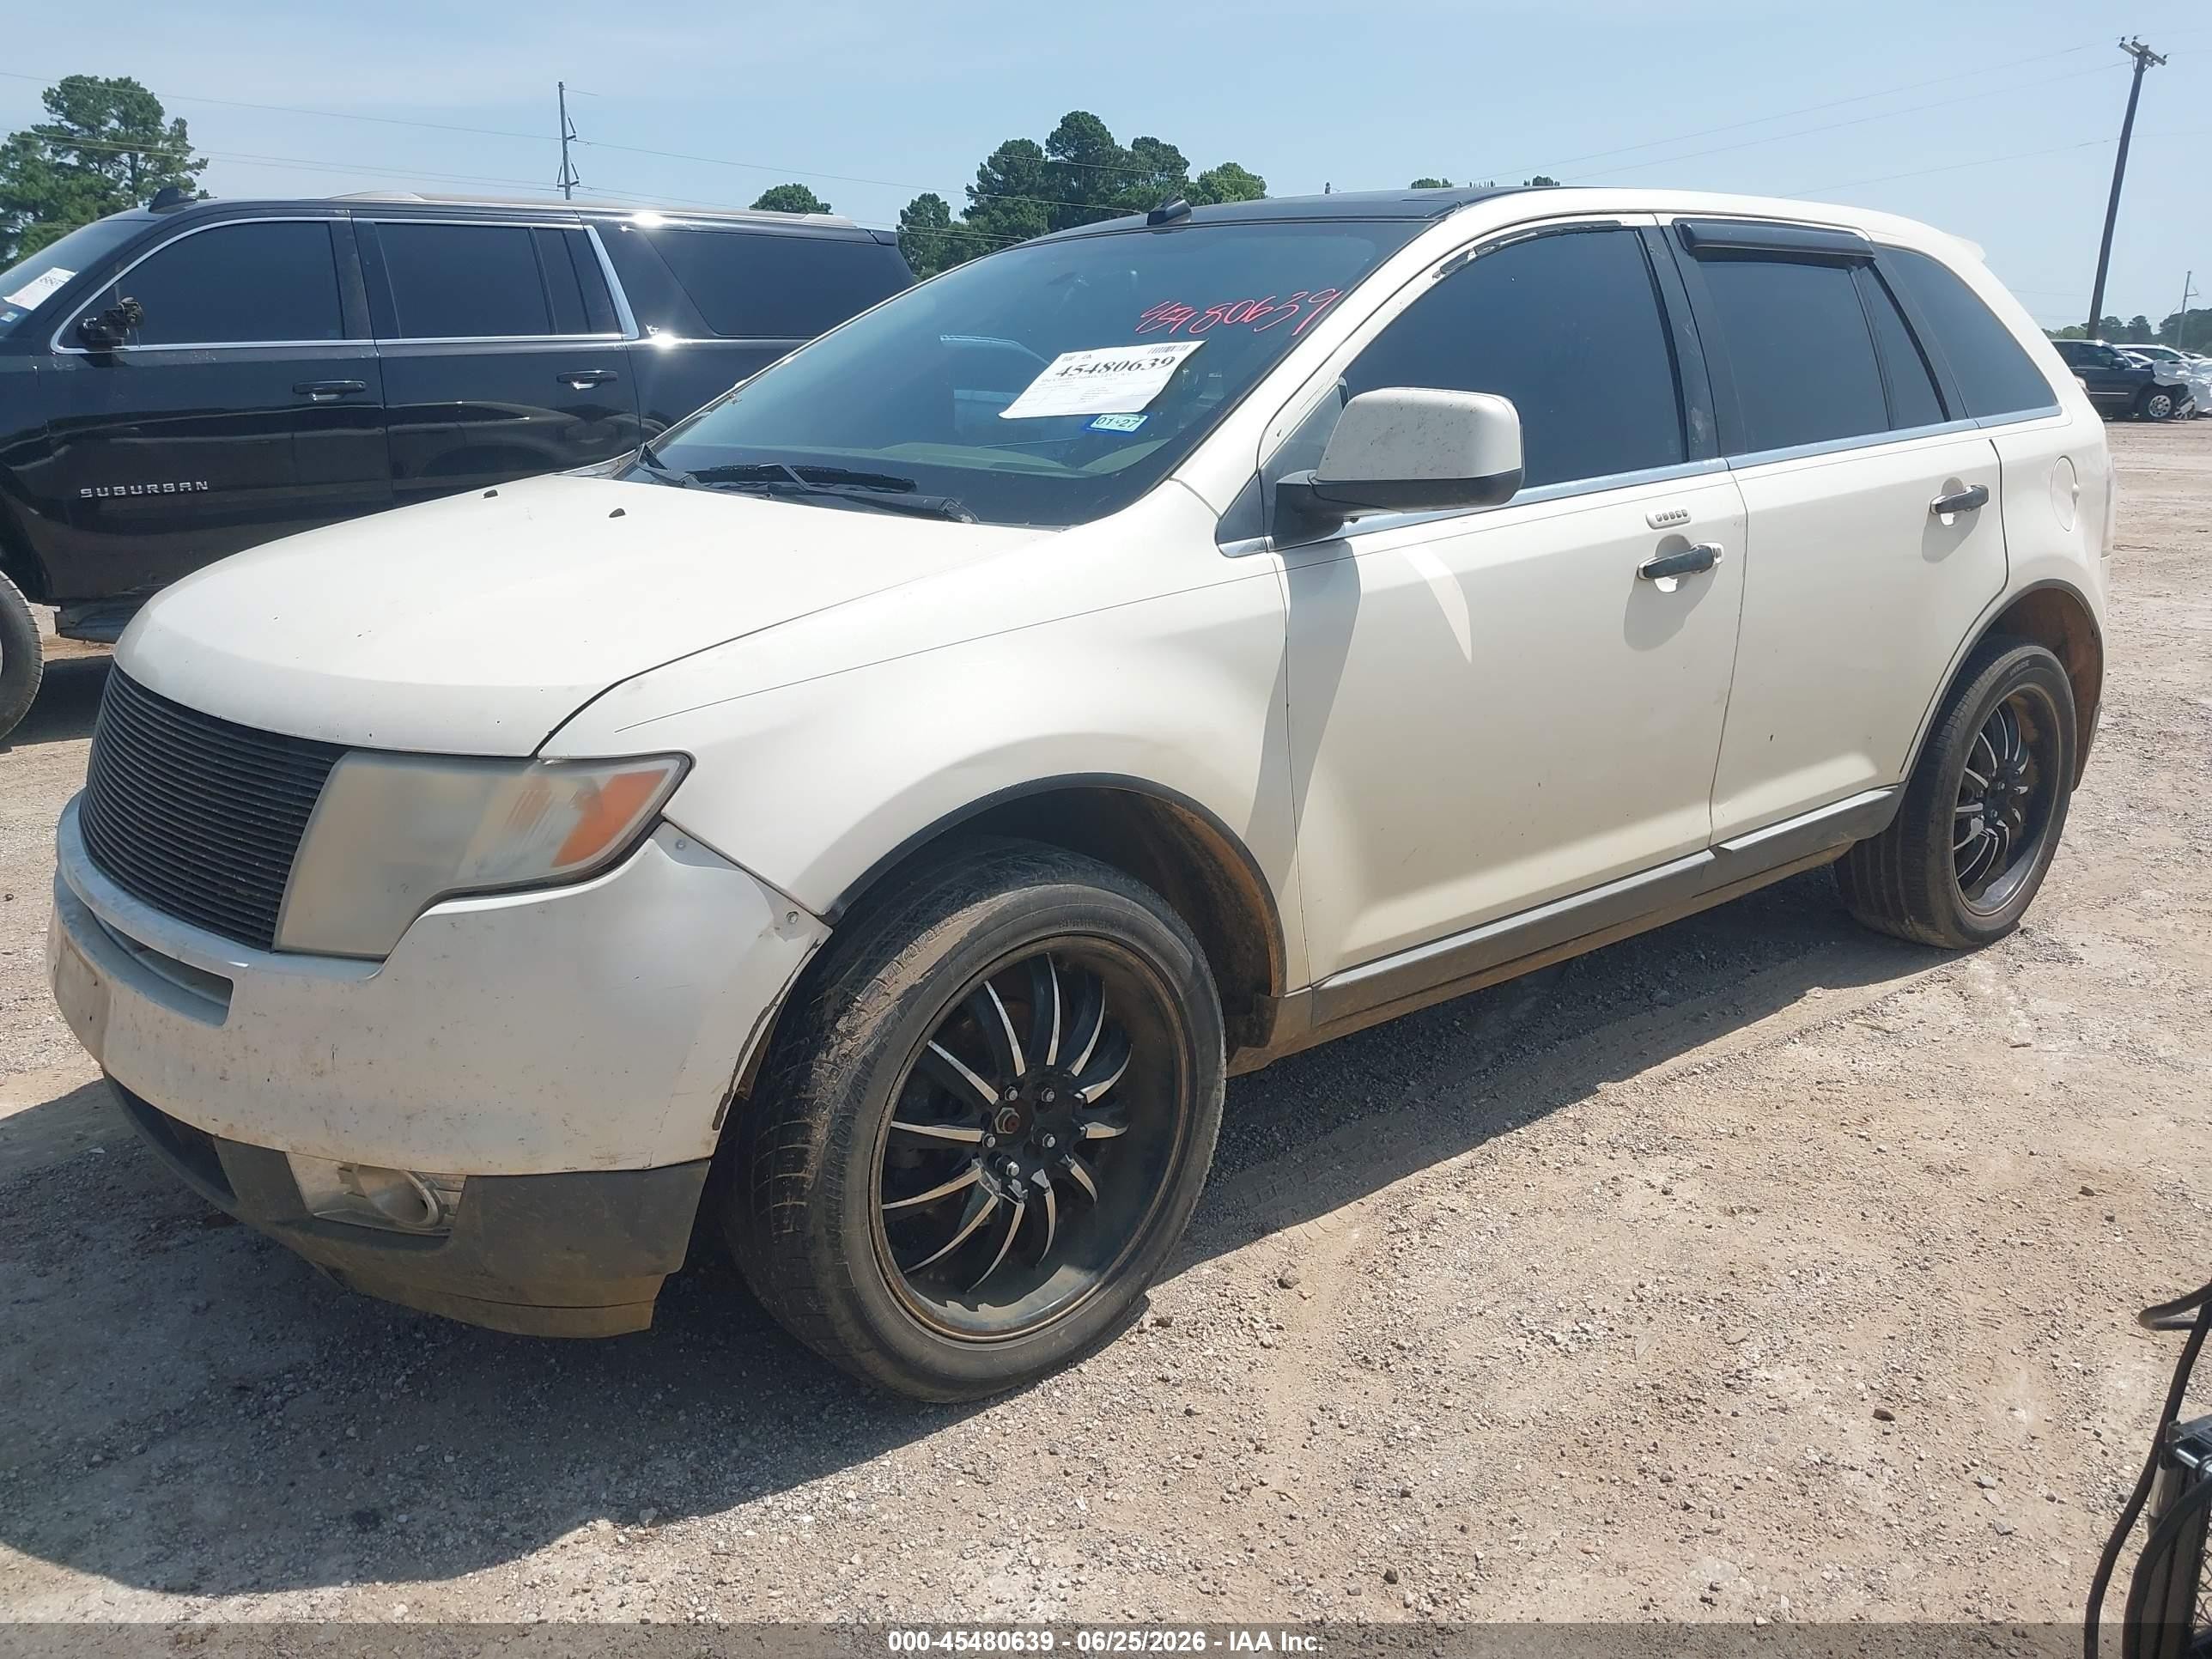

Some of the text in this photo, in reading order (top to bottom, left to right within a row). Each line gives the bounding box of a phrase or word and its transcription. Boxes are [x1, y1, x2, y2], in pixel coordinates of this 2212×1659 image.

[1135, 288, 1344, 337] 45480639
[1055, 356, 1176, 377] 45480639
[79, 480, 210, 499] SUBURBAN
